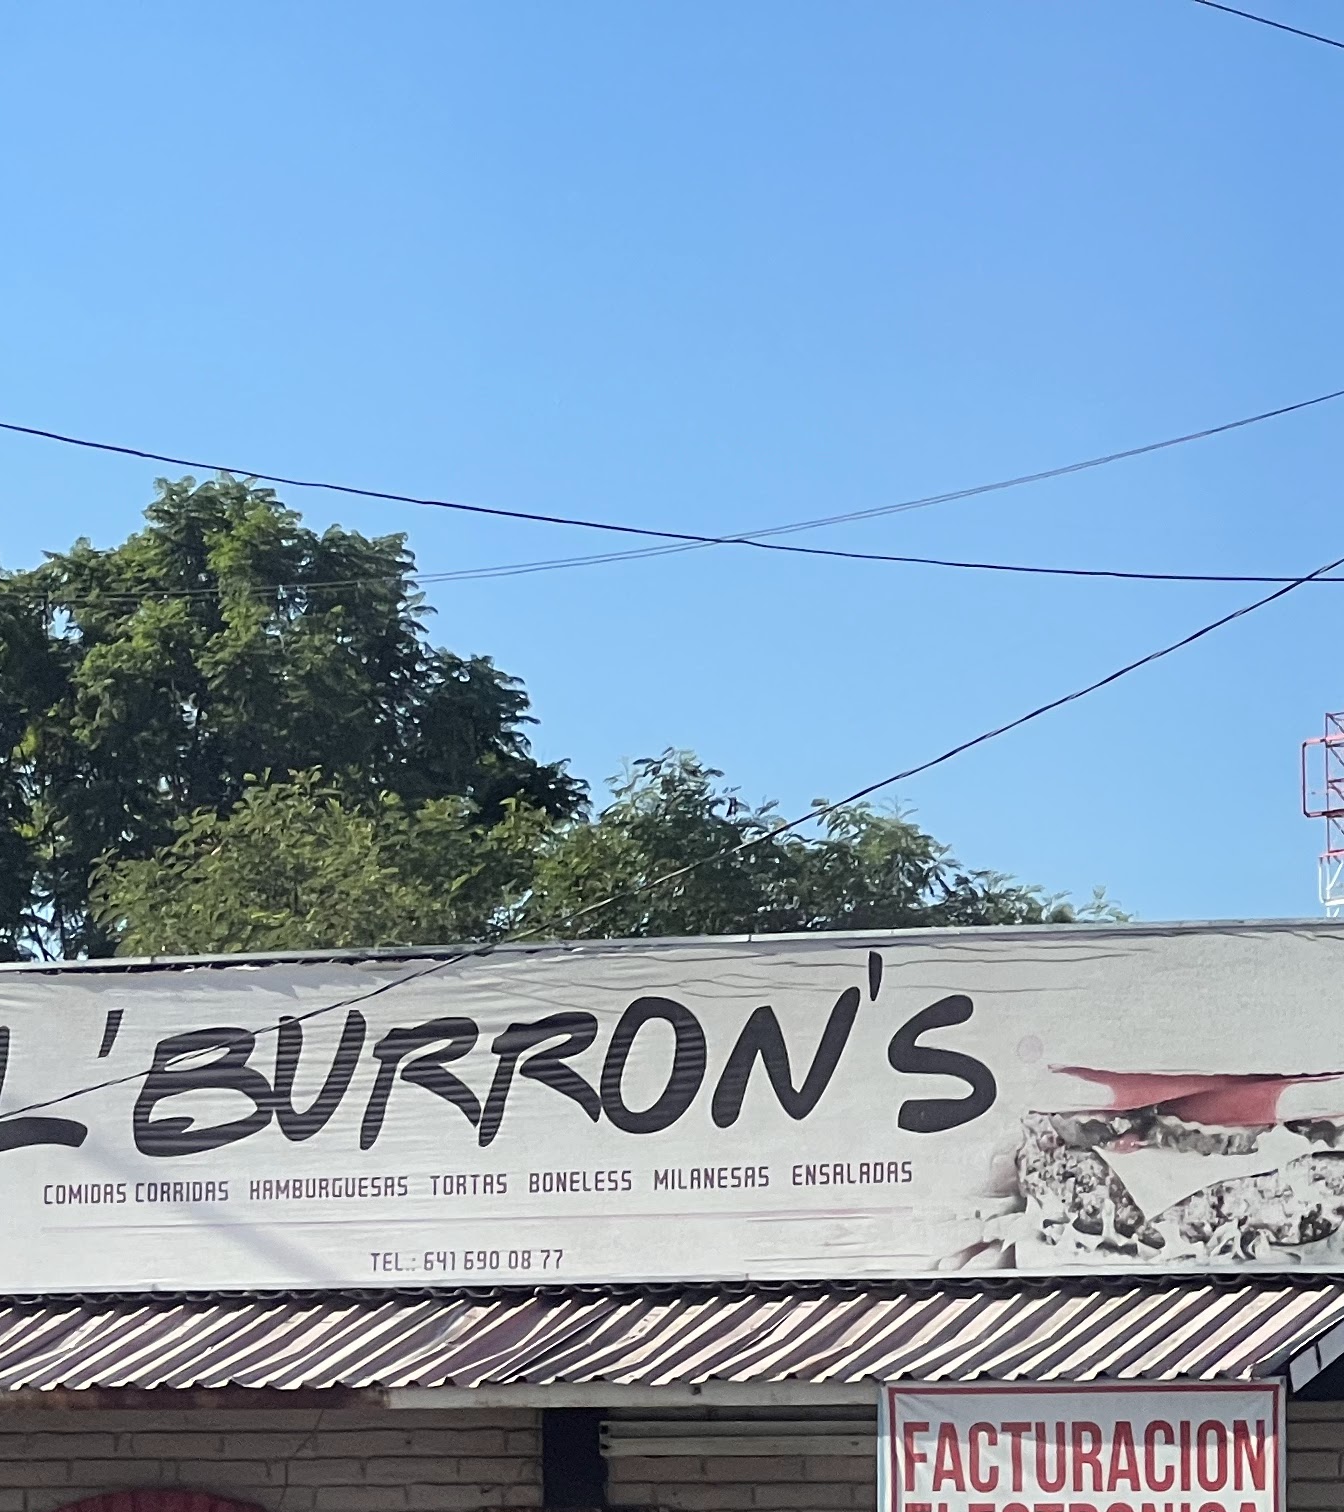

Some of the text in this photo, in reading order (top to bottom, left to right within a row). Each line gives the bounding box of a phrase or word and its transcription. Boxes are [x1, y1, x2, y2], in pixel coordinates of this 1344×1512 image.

[42, 1161, 913, 1205] COMIDAS CORRIDAS HAMBURGUESAS TORTAS BONELESS MILANESAS ENSALADAS
[423, 1251, 456, 1271] 641
[463, 1250, 500, 1270] 690
[508, 1250, 532, 1269] 08
[540, 1249, 564, 1269] 77
[903, 1419, 1267, 1493] FACTURACION
